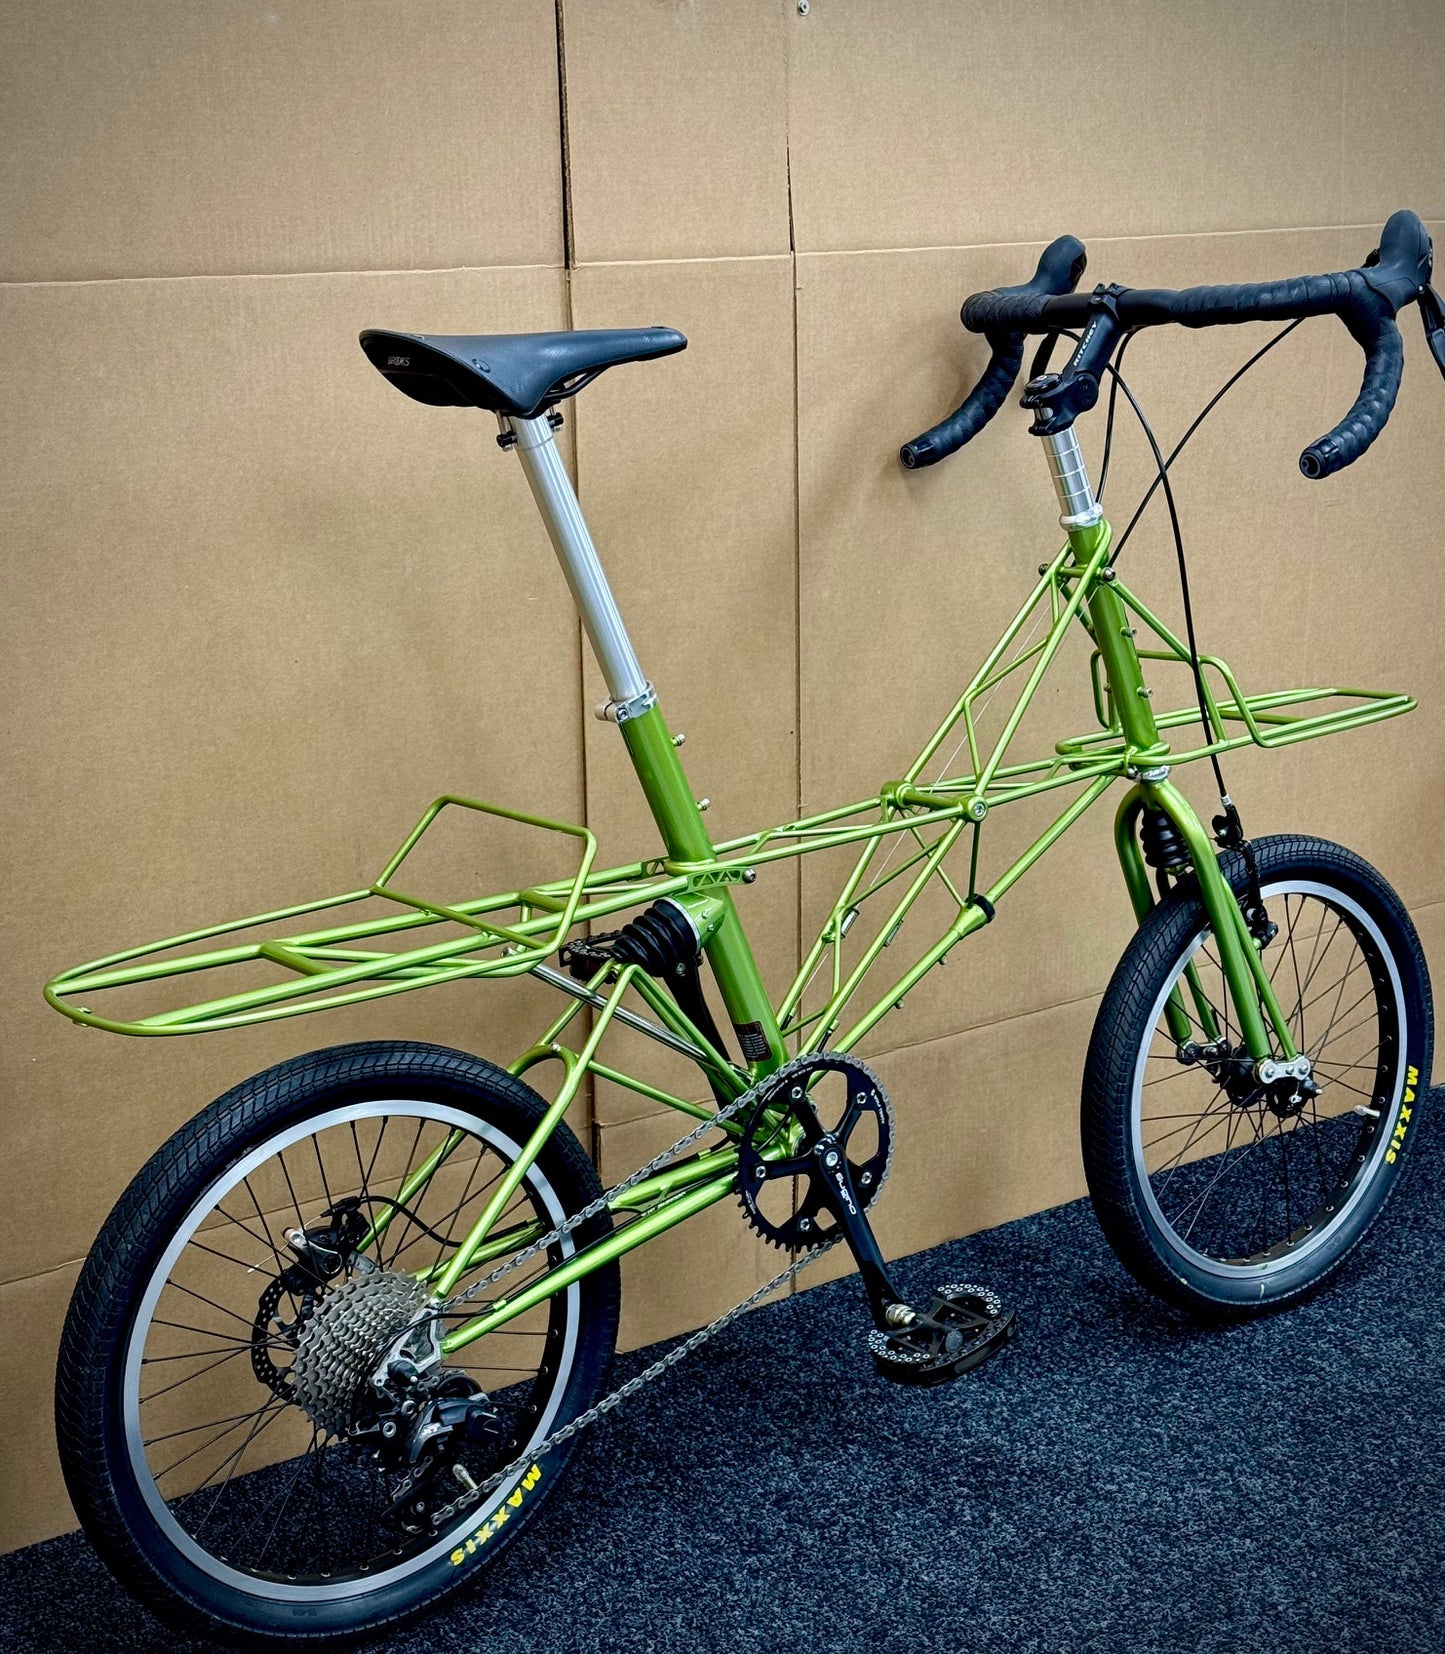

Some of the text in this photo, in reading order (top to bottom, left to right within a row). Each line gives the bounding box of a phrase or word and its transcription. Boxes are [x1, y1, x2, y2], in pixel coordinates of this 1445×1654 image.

[387, 355, 411, 366] BROOKS
[1073, 320, 1097, 367] RITCHEY
[1385, 1065, 1419, 1165] MAXXIS
[450, 1464, 542, 1566] MAXXIS
